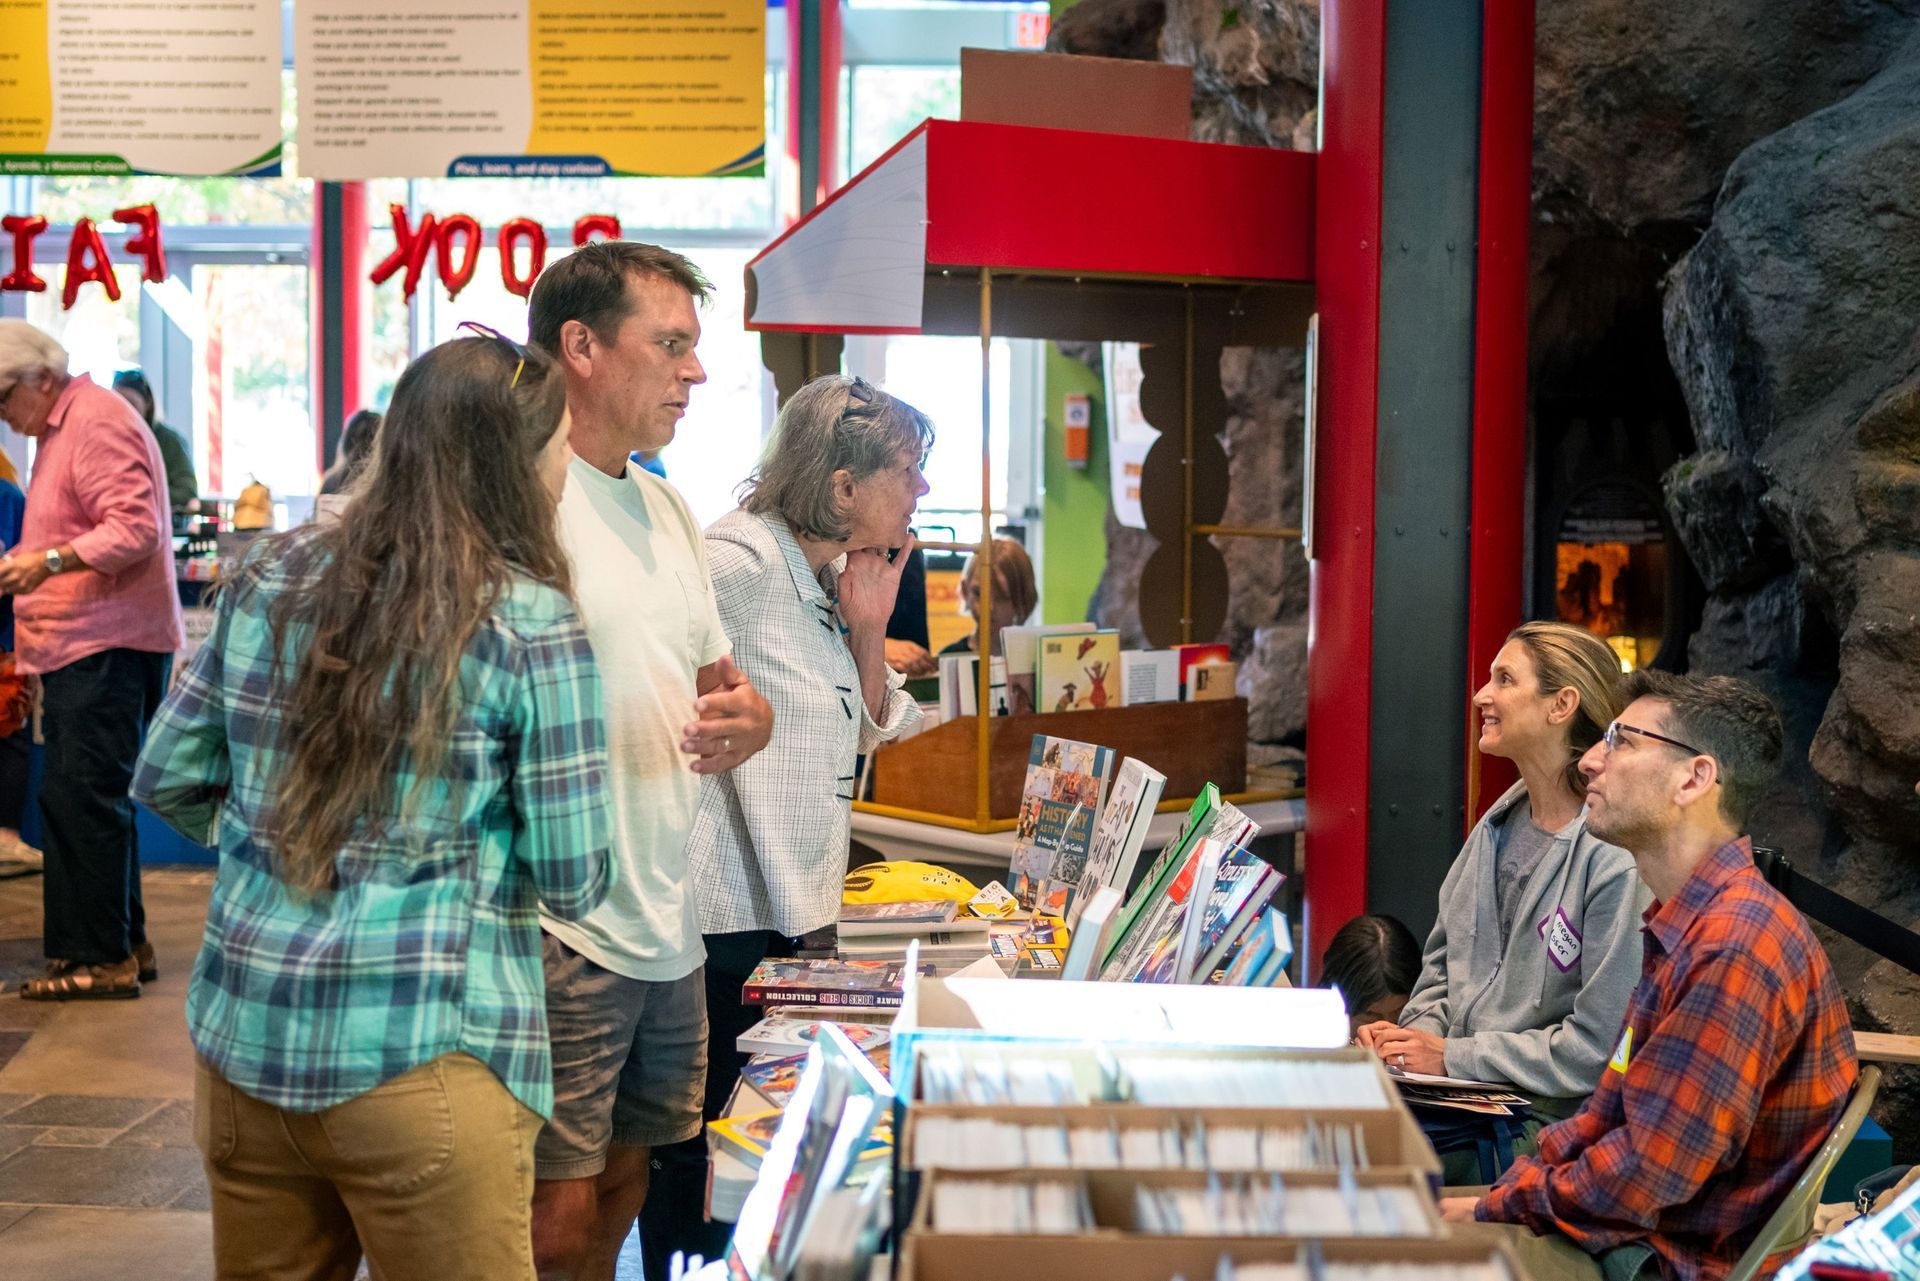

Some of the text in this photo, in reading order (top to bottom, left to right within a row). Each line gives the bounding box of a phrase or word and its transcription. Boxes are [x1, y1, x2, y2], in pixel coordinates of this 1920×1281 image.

[1053, 826, 1086, 842] HAENED
[1550, 928, 1569, 956] sser
[766, 992, 817, 1002] COLLECTION
[819, 993, 840, 1004] GEMS
[849, 995, 874, 1005] ROCKS
[876, 995, 904, 1005] IMATE
